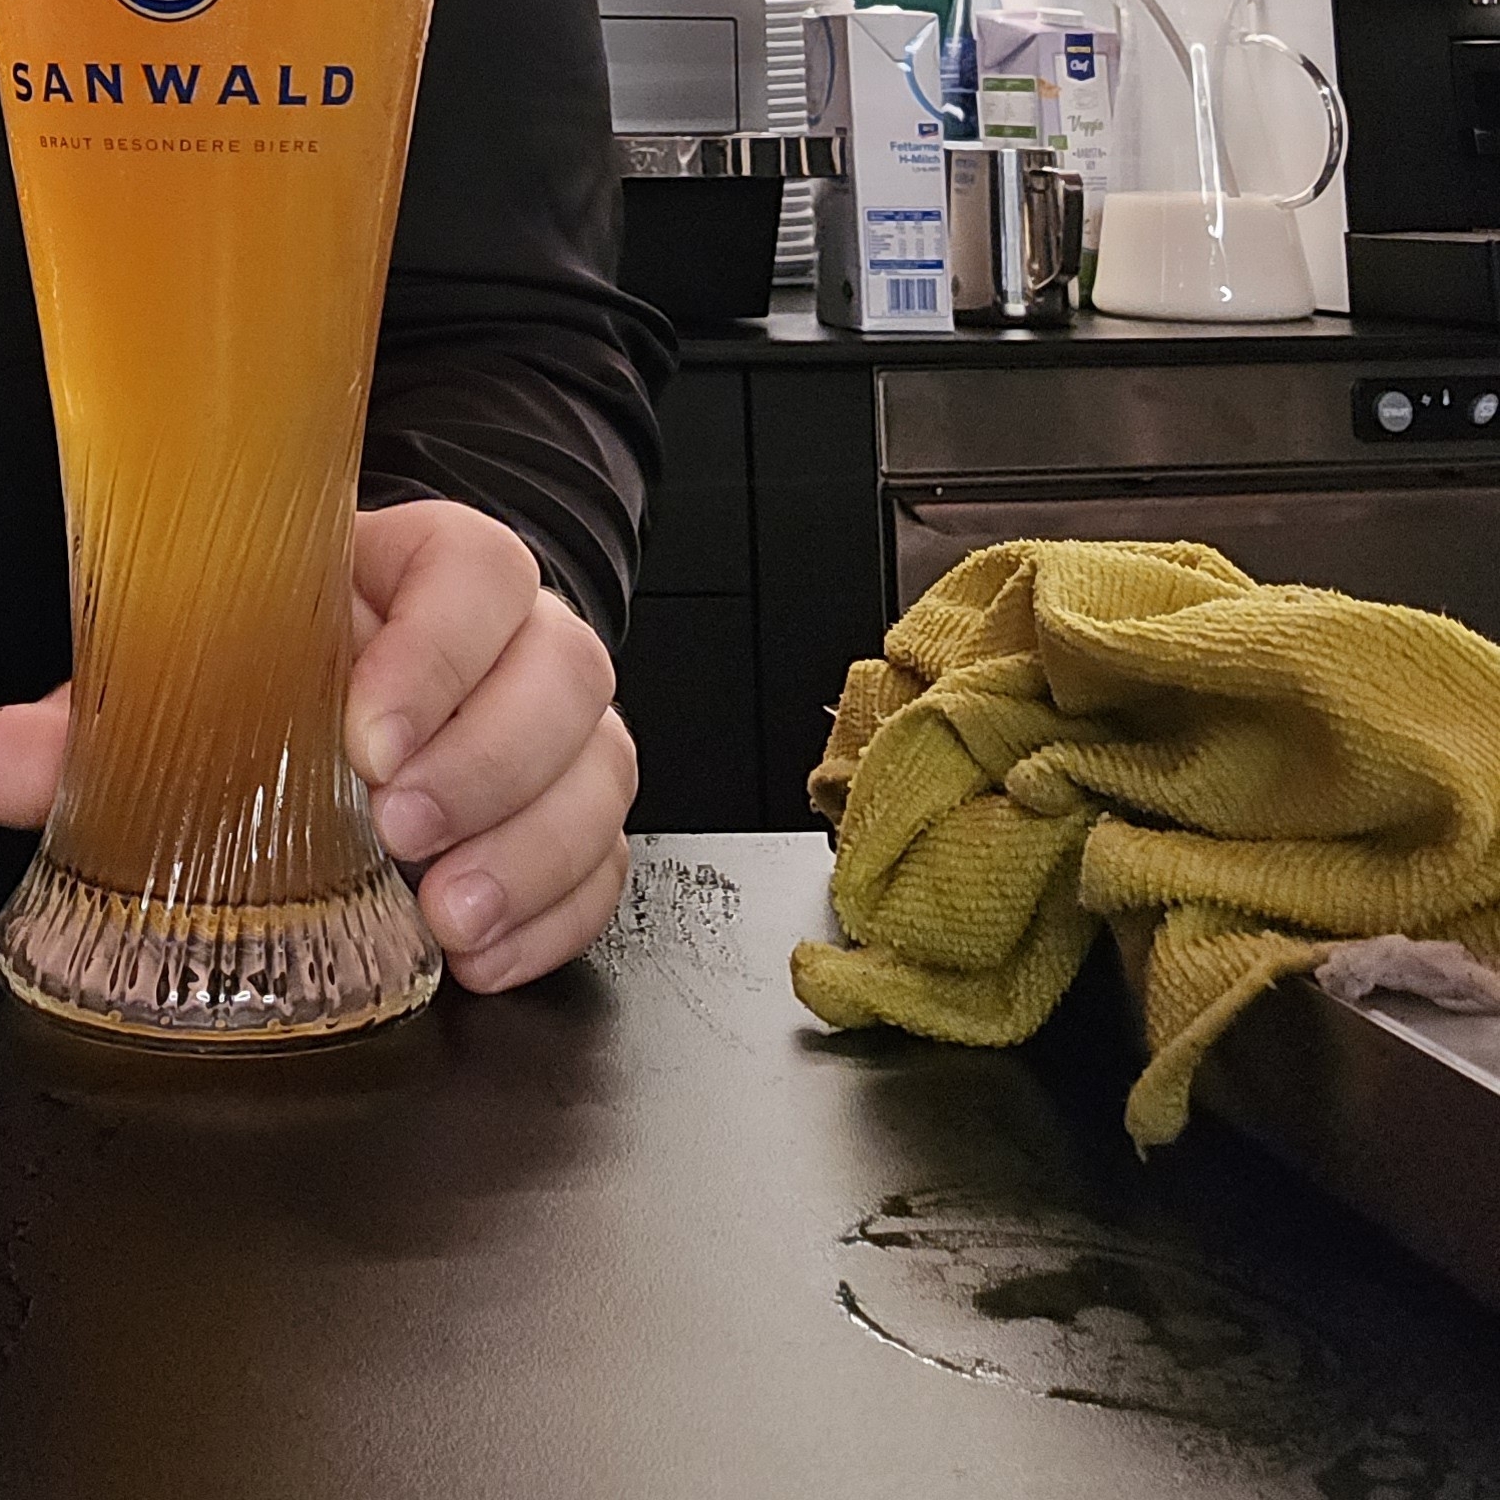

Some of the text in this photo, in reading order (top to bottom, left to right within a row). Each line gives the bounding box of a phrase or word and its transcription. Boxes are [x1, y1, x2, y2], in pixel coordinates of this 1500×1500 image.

[12, 62, 354, 106] SANWALD
[40, 135, 319, 153] BRAUT BESONDERE BIERE
